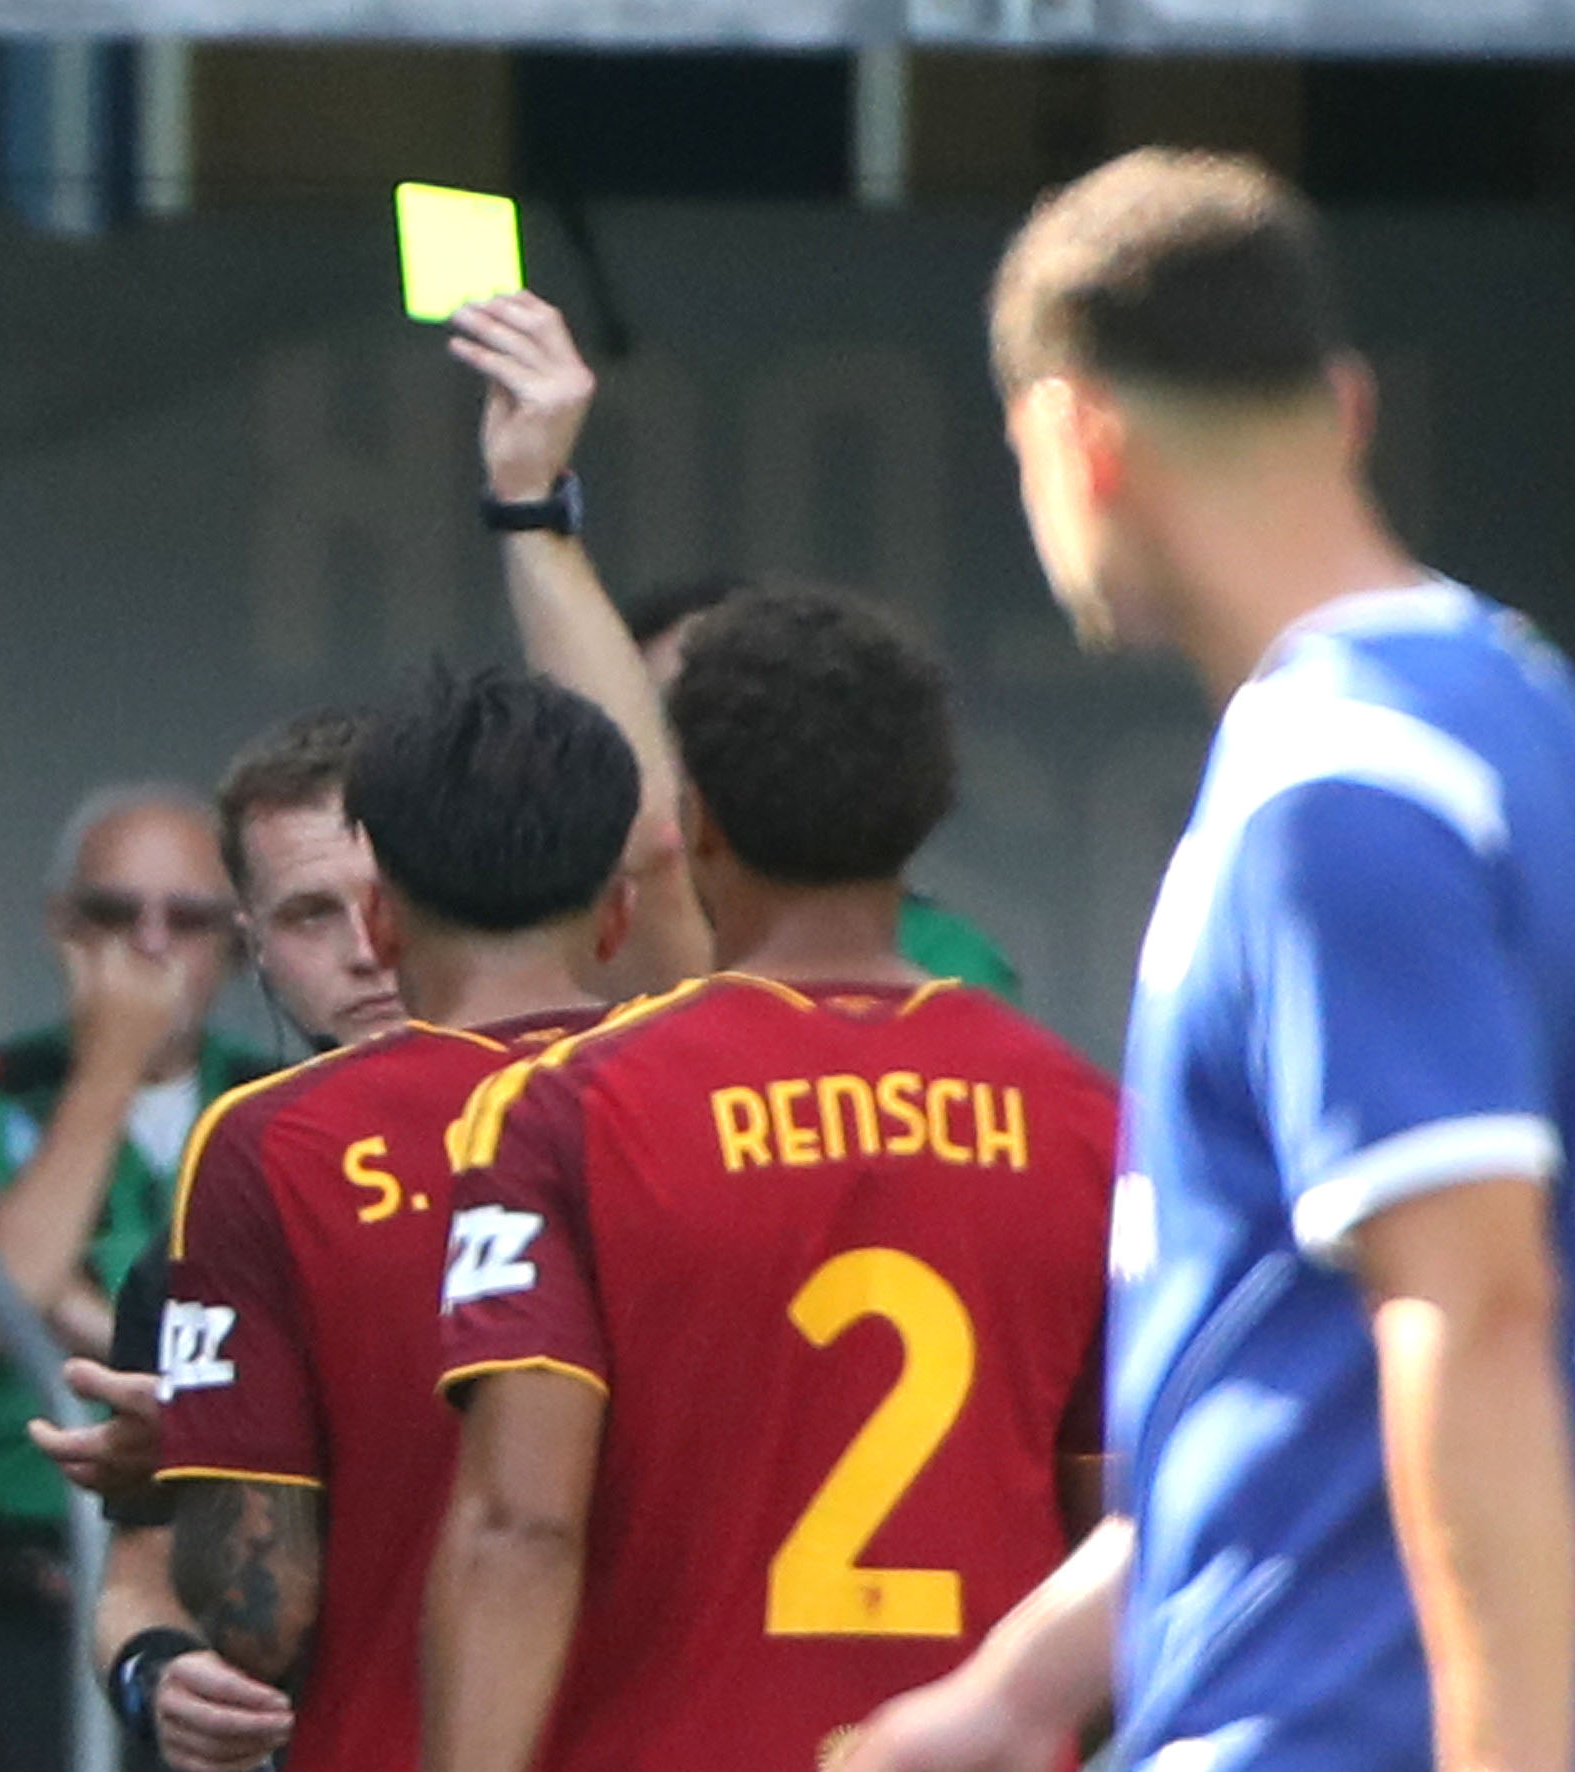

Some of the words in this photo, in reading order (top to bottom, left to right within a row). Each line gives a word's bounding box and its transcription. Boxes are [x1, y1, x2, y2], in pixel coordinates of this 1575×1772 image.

[710, 1071, 1028, 1171] RENSCH
[342, 1135, 429, 1223] S.
[763, 1247, 975, 1636] 2
